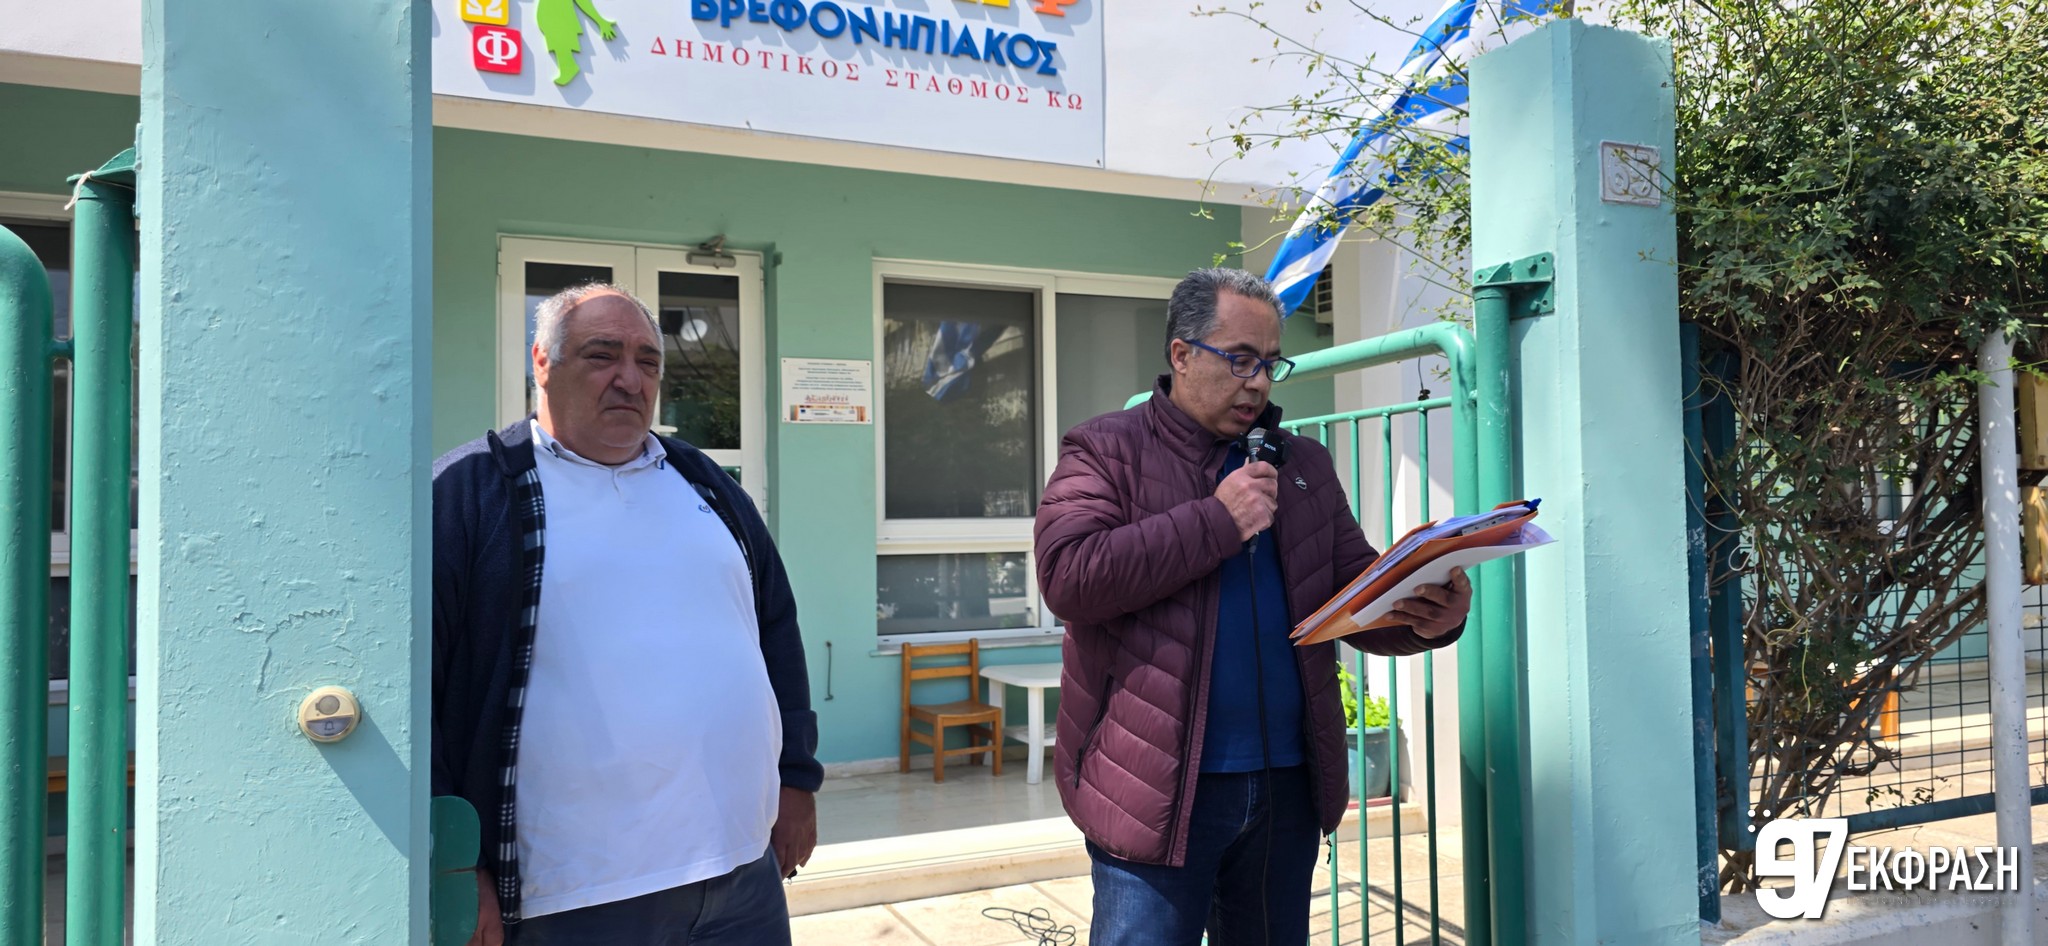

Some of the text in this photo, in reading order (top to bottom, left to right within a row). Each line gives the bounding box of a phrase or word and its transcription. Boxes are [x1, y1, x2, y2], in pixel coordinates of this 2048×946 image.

[476, 29, 519, 66] Φ
[650, 36, 1082, 110] ΔΗΜΟΤΙΚΟΣ ΣΤΑΘΜΟΣ ΚΩ
[691, 0, 1058, 77] ΒΡΕΦΟΝΗΠΙΑΚΟΣ
